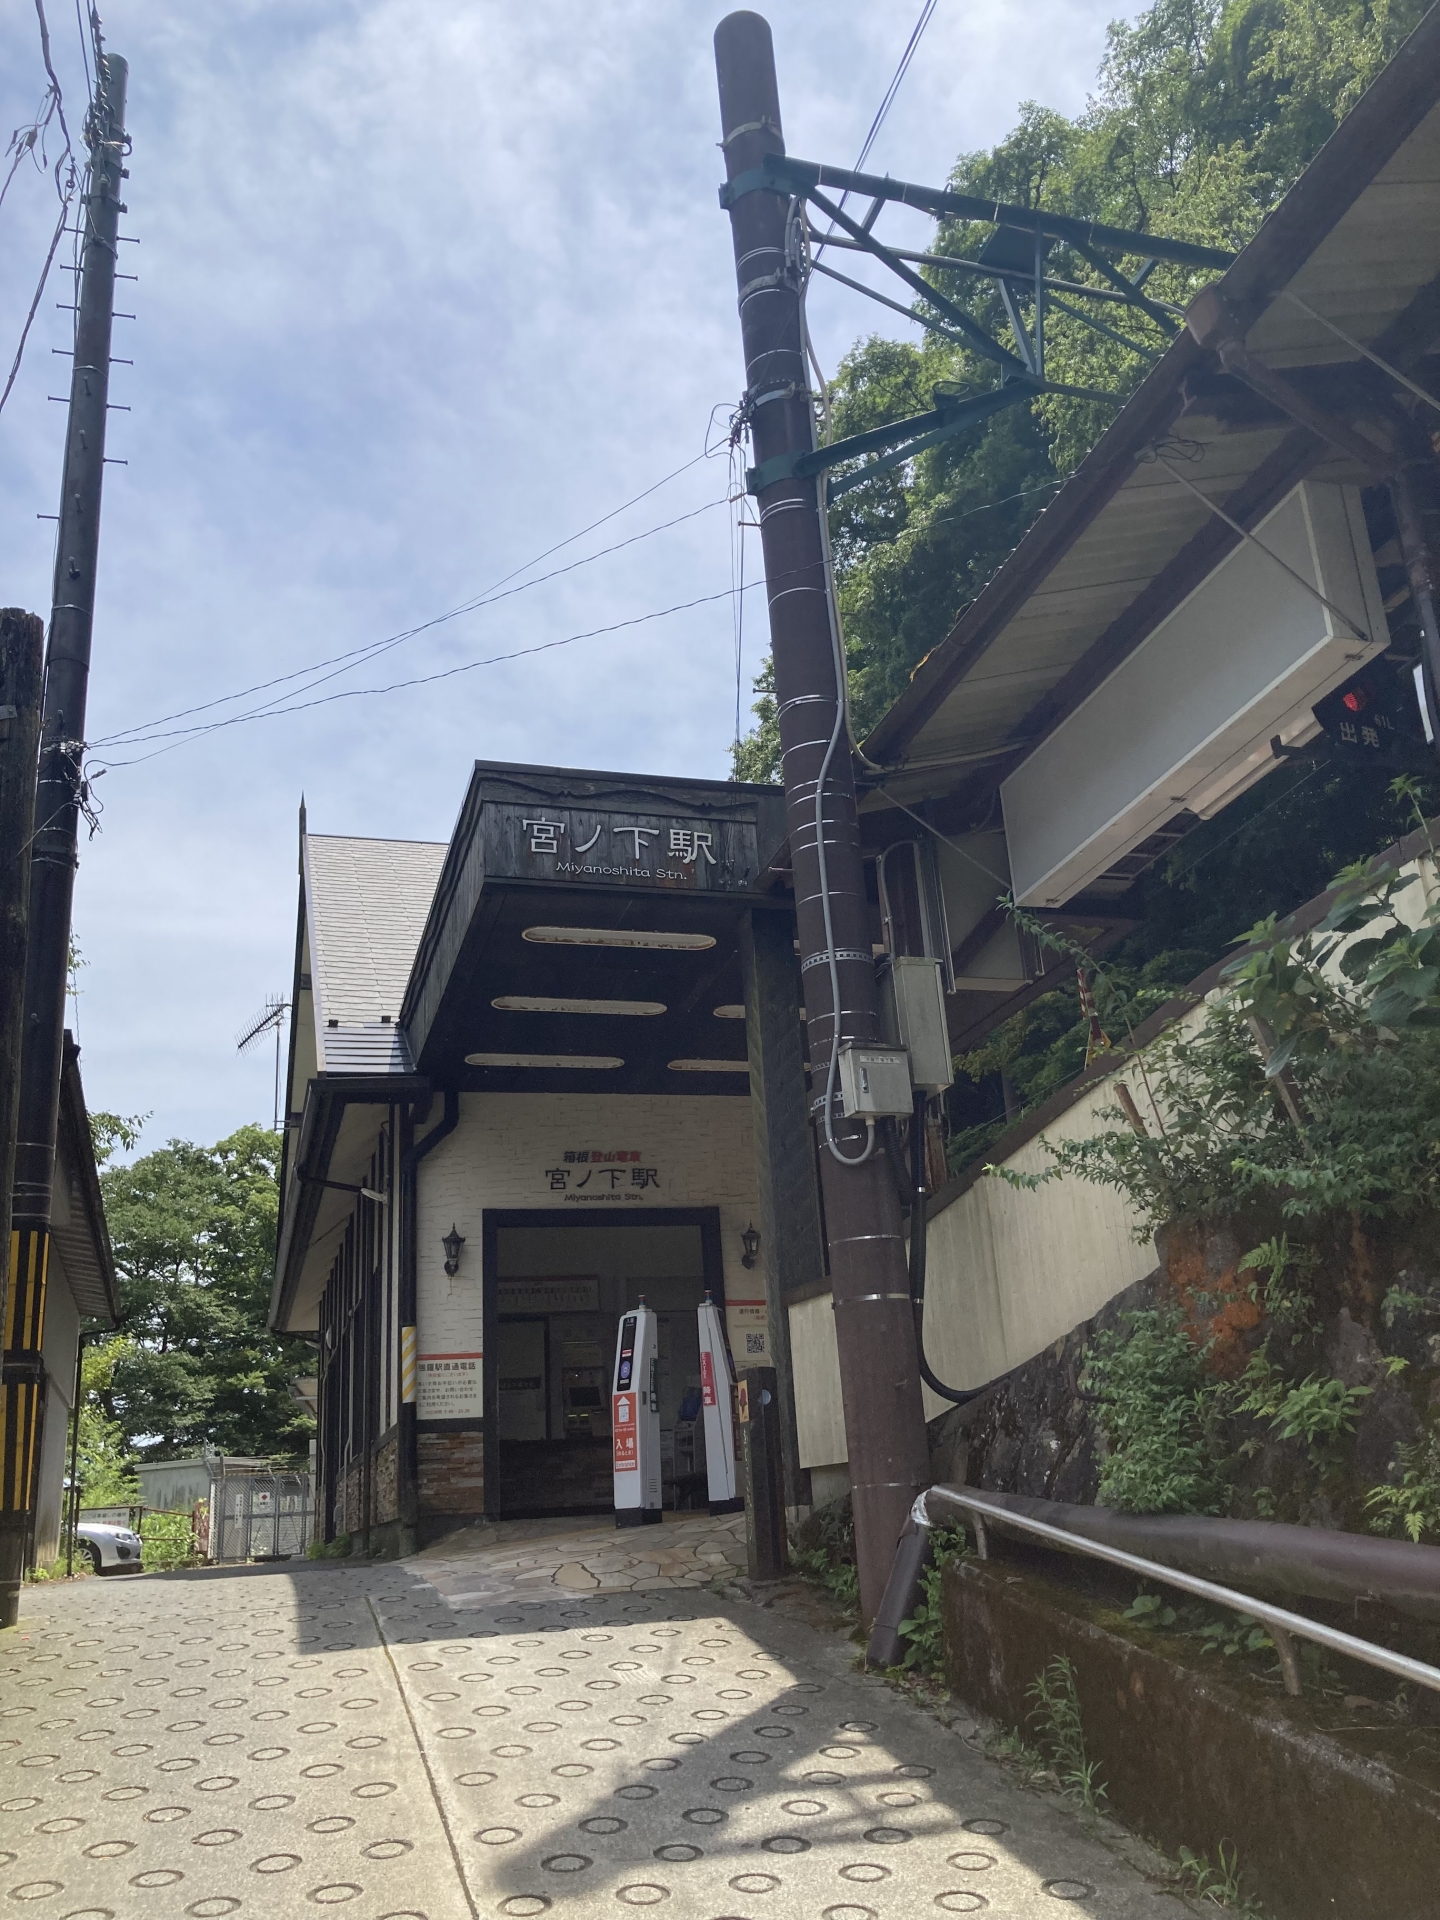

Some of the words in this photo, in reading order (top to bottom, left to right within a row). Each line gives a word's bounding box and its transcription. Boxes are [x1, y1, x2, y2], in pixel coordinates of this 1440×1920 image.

[1339, 721, 1380, 748] 出発
[522, 816, 717, 865] 宮ノ下駅
[555, 861, 651, 877] Miyanoshita
[656, 868, 687, 880] Stn.
[563, 1150, 642, 1164] 箱根登山電車
[545, 1167, 661, 1190] 宮ノ下駅
[564, 1193, 621, 1202] Miyanoshita
[624, 1193, 644, 1201] Stn.
[615, 1437, 634, 1450] 入場
